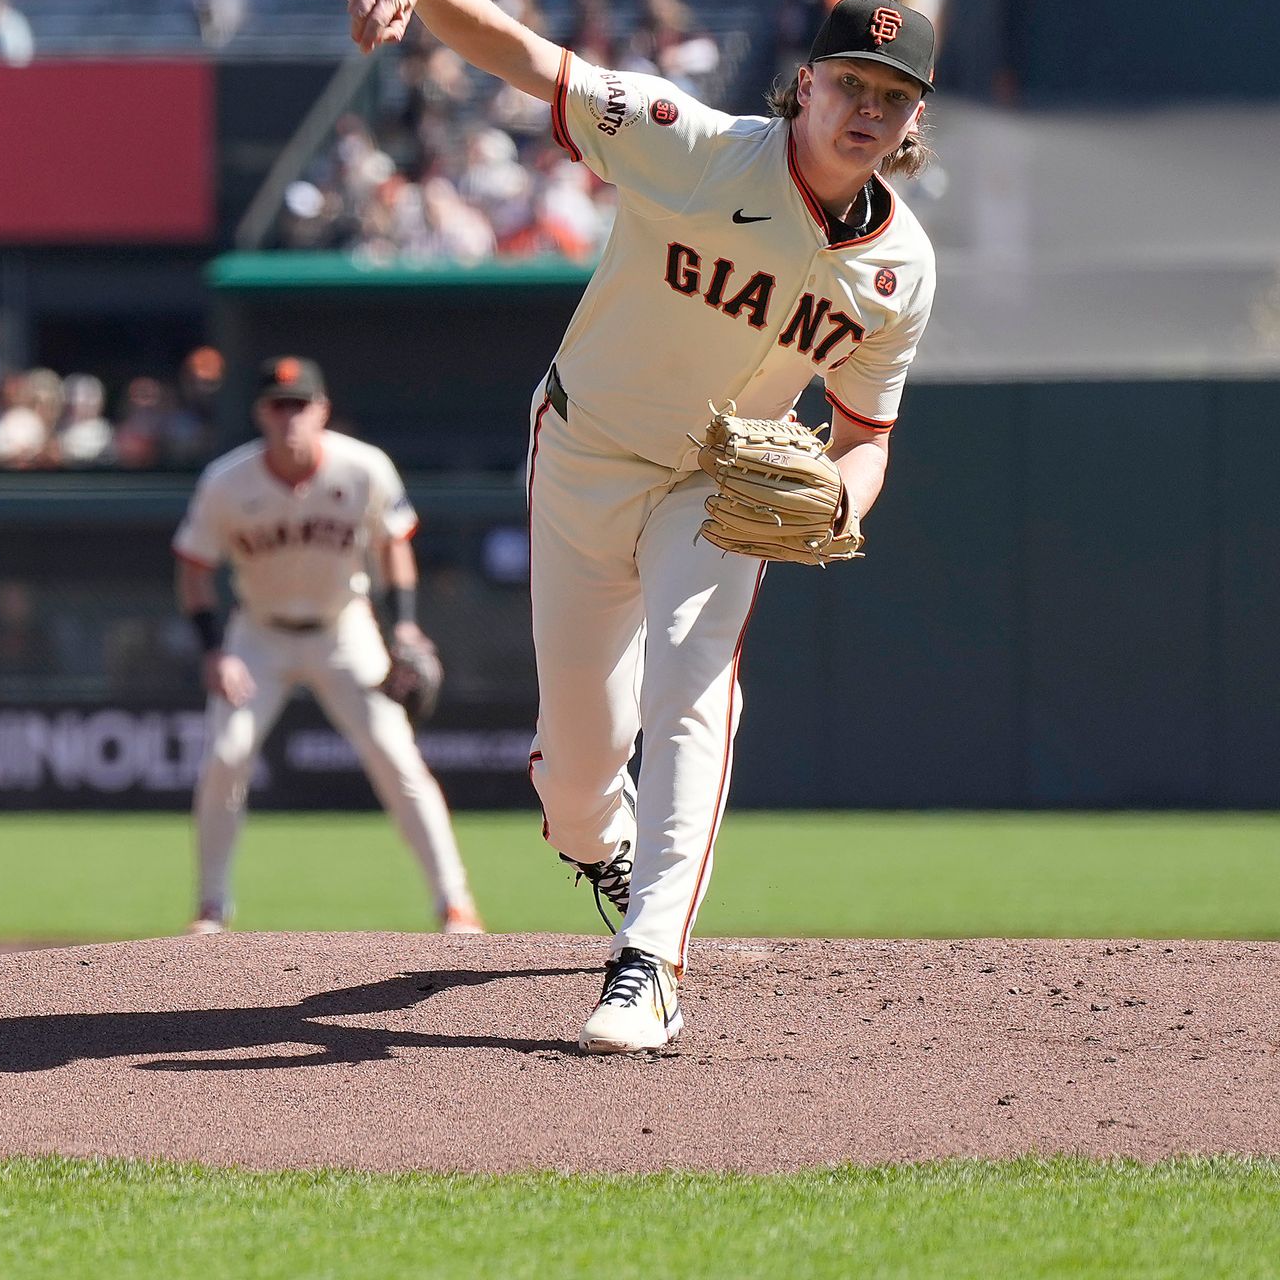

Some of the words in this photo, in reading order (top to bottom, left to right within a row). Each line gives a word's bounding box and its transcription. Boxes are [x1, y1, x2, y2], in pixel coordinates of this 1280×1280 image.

[870, 6, 903, 46] SF
[597, 73, 626, 136] GIANTS
[655, 101, 669, 120] 30
[877, 275, 894, 294] 24
[664, 241, 866, 370] GIANT
